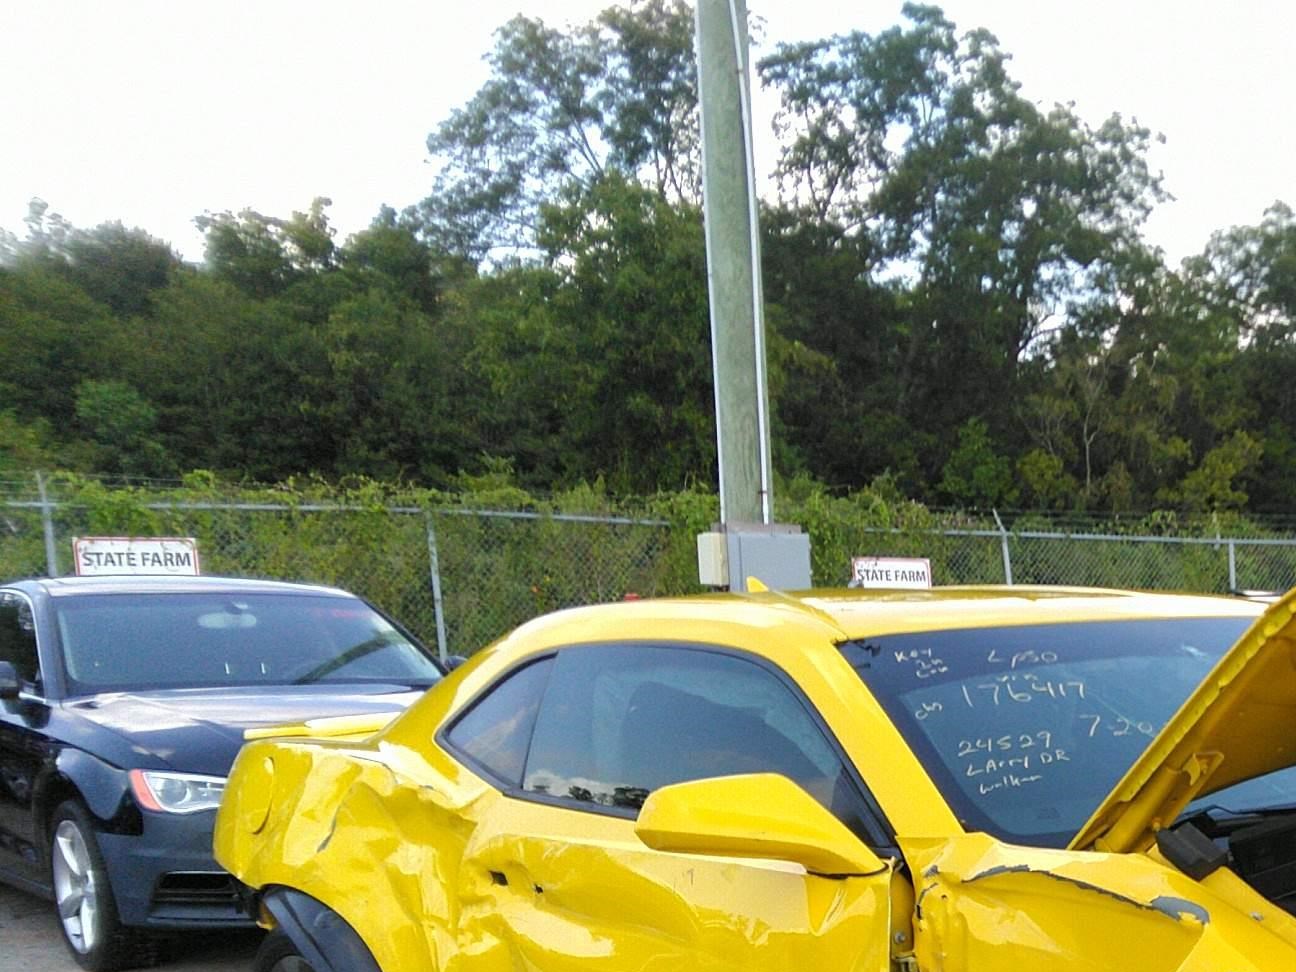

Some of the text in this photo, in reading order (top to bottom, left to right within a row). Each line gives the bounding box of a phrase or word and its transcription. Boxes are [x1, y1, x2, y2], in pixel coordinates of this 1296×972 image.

[82, 551, 191, 567] STATE FARM
[857, 568, 926, 582] STATE FARM
[961, 680, 1086, 708] 176417
[958, 730, 1051, 757] 24529
